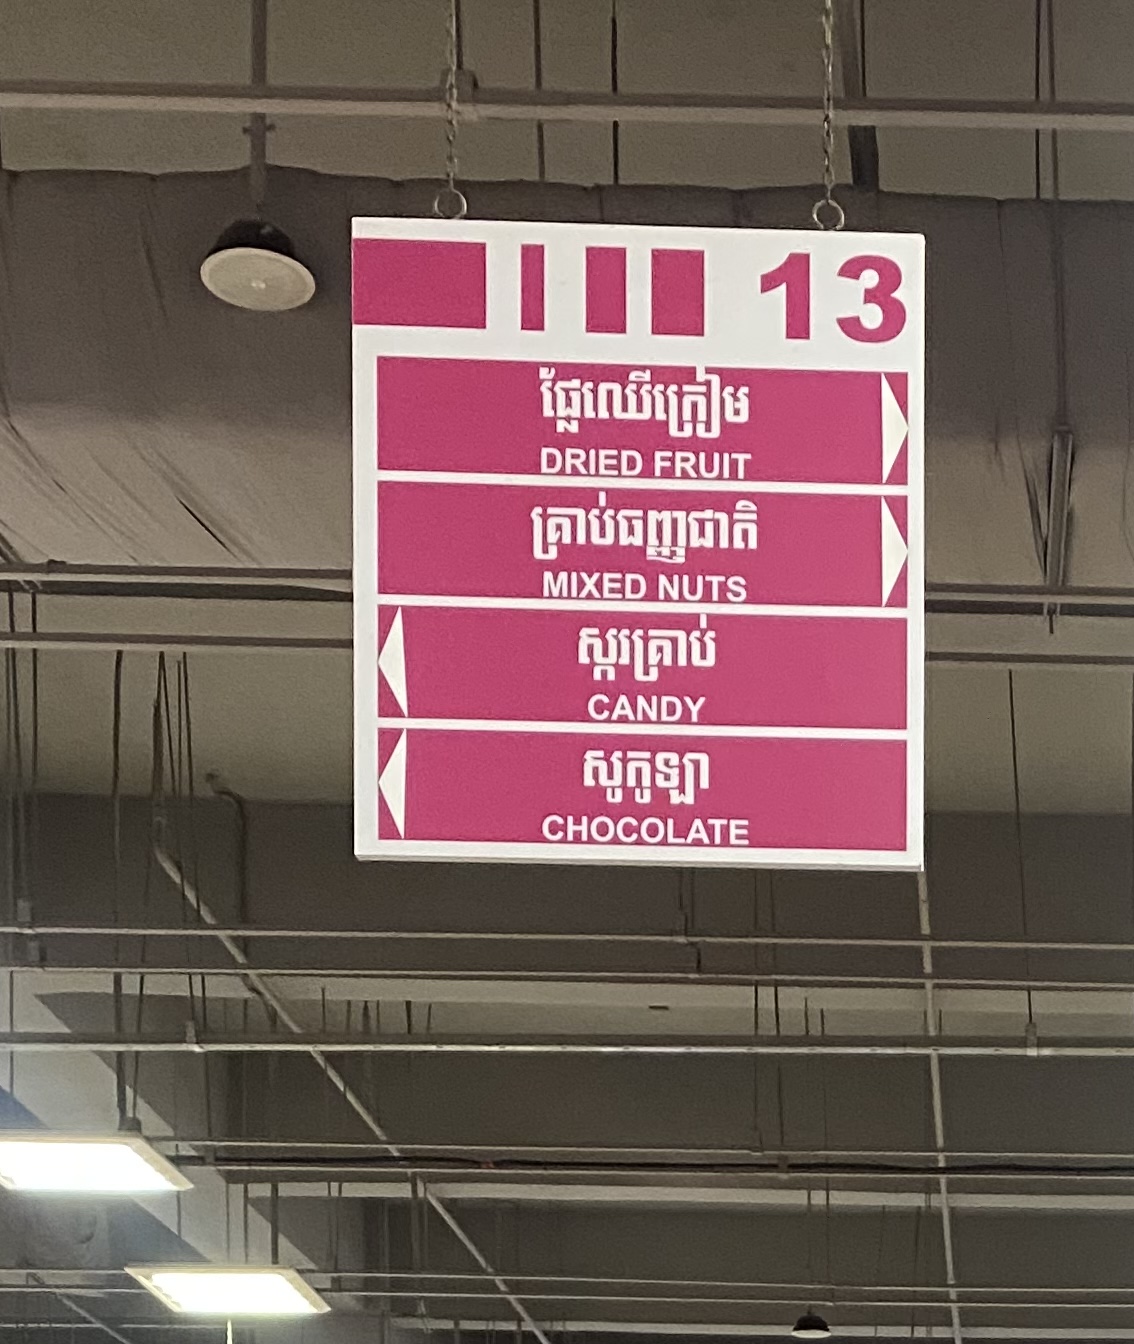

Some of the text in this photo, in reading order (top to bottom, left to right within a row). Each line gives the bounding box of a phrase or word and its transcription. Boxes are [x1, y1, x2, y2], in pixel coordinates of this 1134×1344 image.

[760, 252, 907, 343] 13
[541, 447, 752, 480] DRIED FRUIT
[542, 571, 748, 603] MIXED NUTS
[587, 694, 706, 723] CANDY
[541, 815, 750, 846] CHOCOLATE
